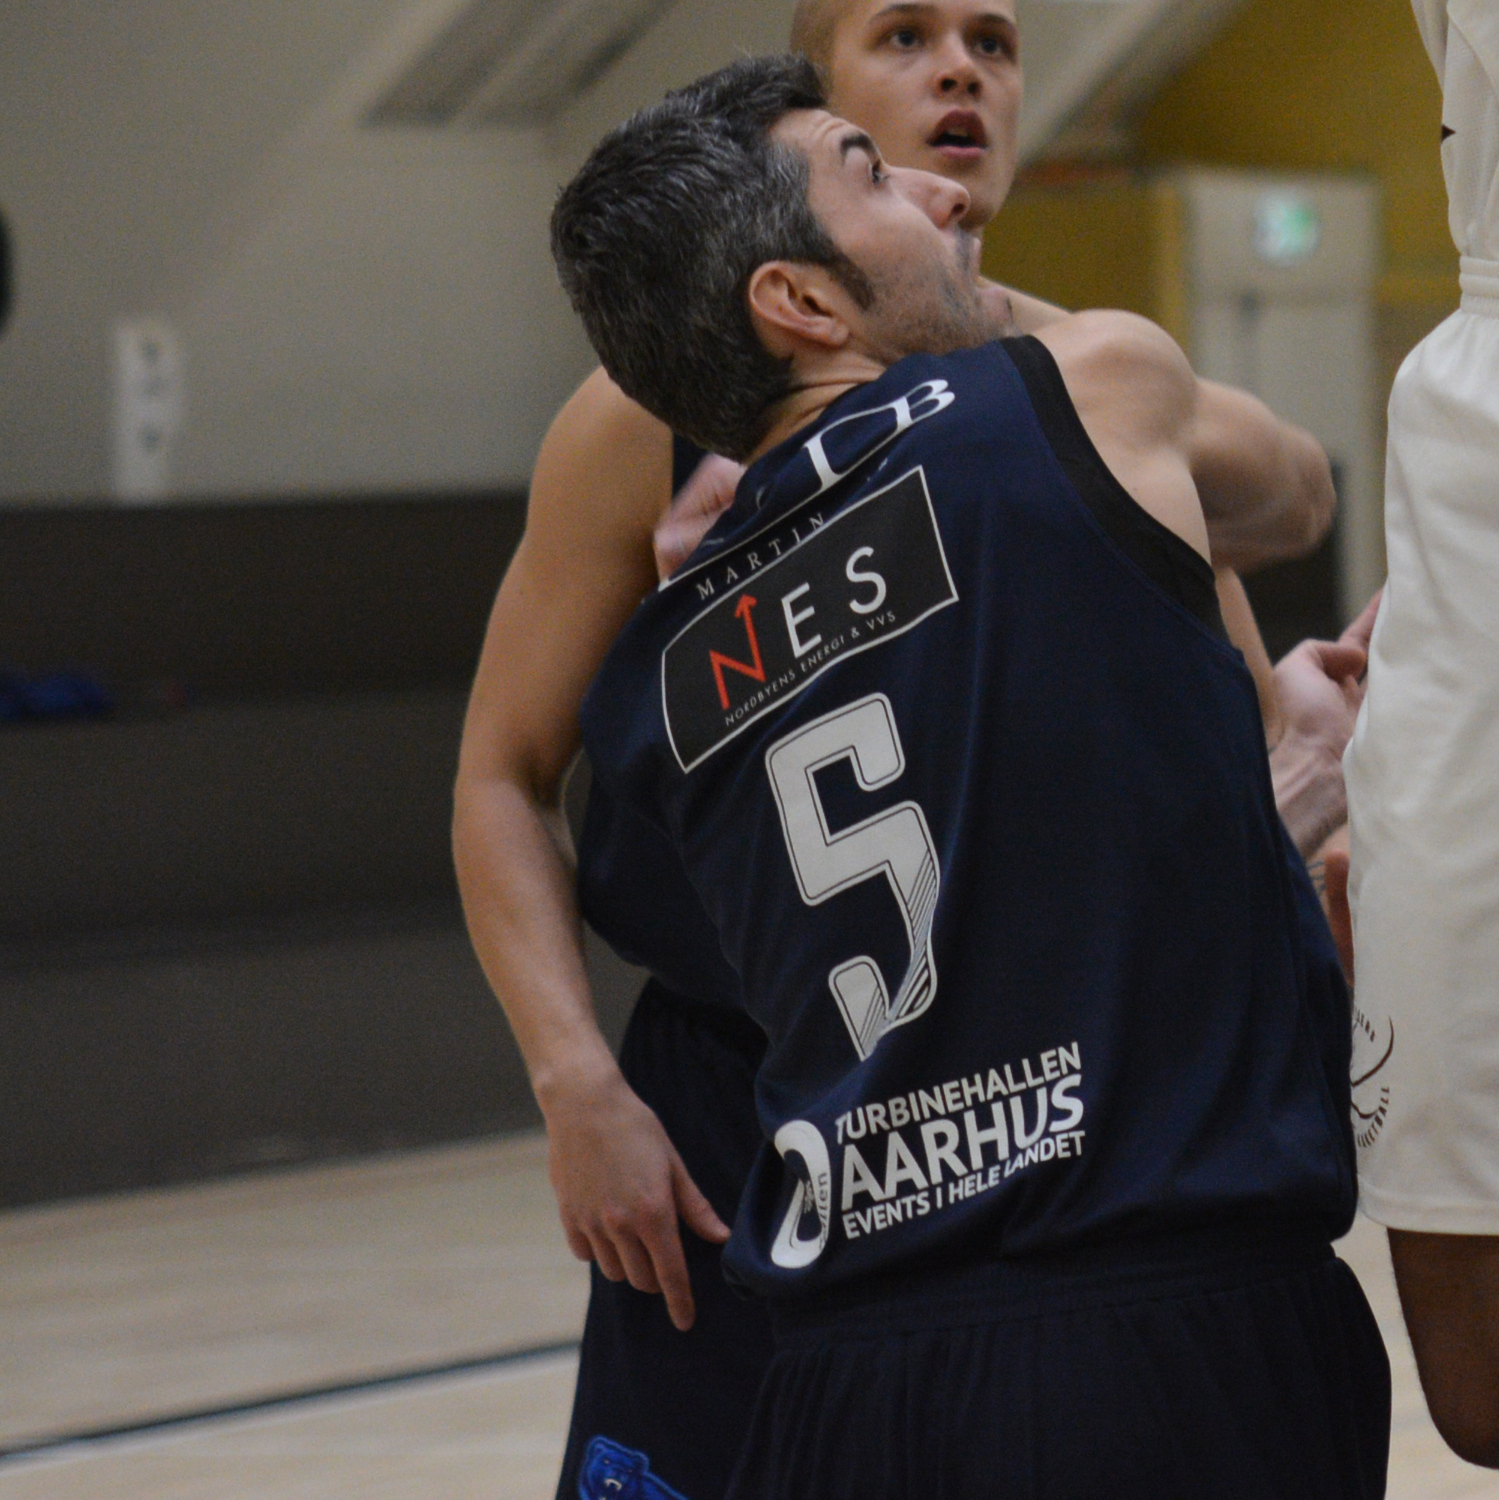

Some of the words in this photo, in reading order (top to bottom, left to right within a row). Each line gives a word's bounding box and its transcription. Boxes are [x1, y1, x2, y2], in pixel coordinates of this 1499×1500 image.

[697, 511, 827, 601] MARTIN
[708, 545, 888, 712] NES
[724, 669, 797, 728] NORDBYENS
[800, 633, 846, 674] ENERGI
[850, 626, 861, 640] &
[865, 609, 897, 632] VVS
[765, 692, 941, 1062] 5
[834, 1041, 1083, 1146] TURBINEHALLEN
[841, 1073, 1085, 1213] AARHUS
[842, 1190, 931, 1240] EVENTS
[936, 1186, 944, 1210] I
[948, 1164, 1002, 1205] HELE
[1003, 1129, 1087, 1179] LANDET
